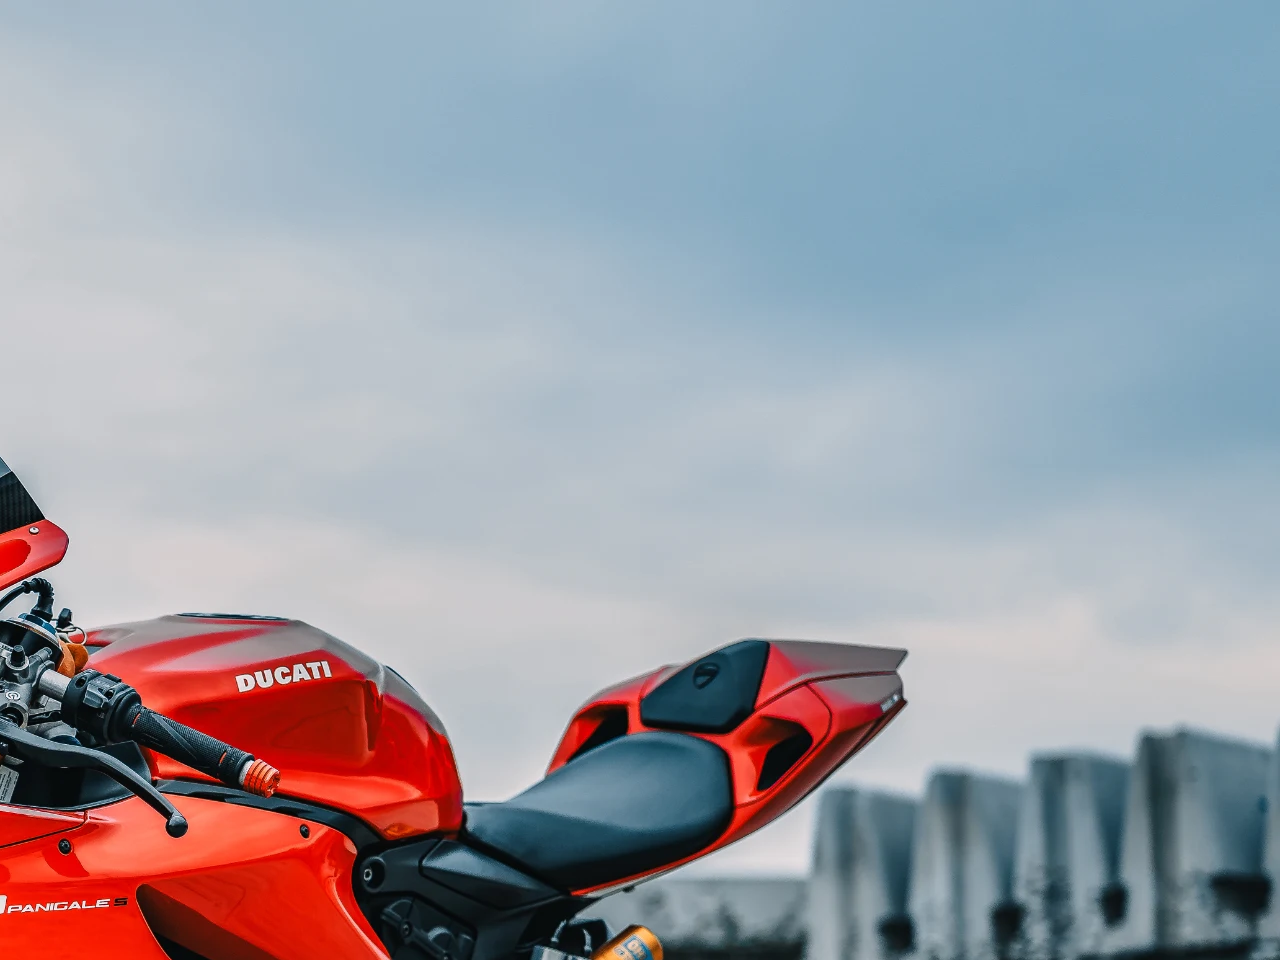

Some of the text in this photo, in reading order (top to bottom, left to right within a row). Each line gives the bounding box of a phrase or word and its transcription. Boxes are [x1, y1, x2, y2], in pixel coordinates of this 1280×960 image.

[235, 660, 332, 693] DUCATI
[7, 898, 111, 914] PANIGALE
[113, 897, 128, 907] S
